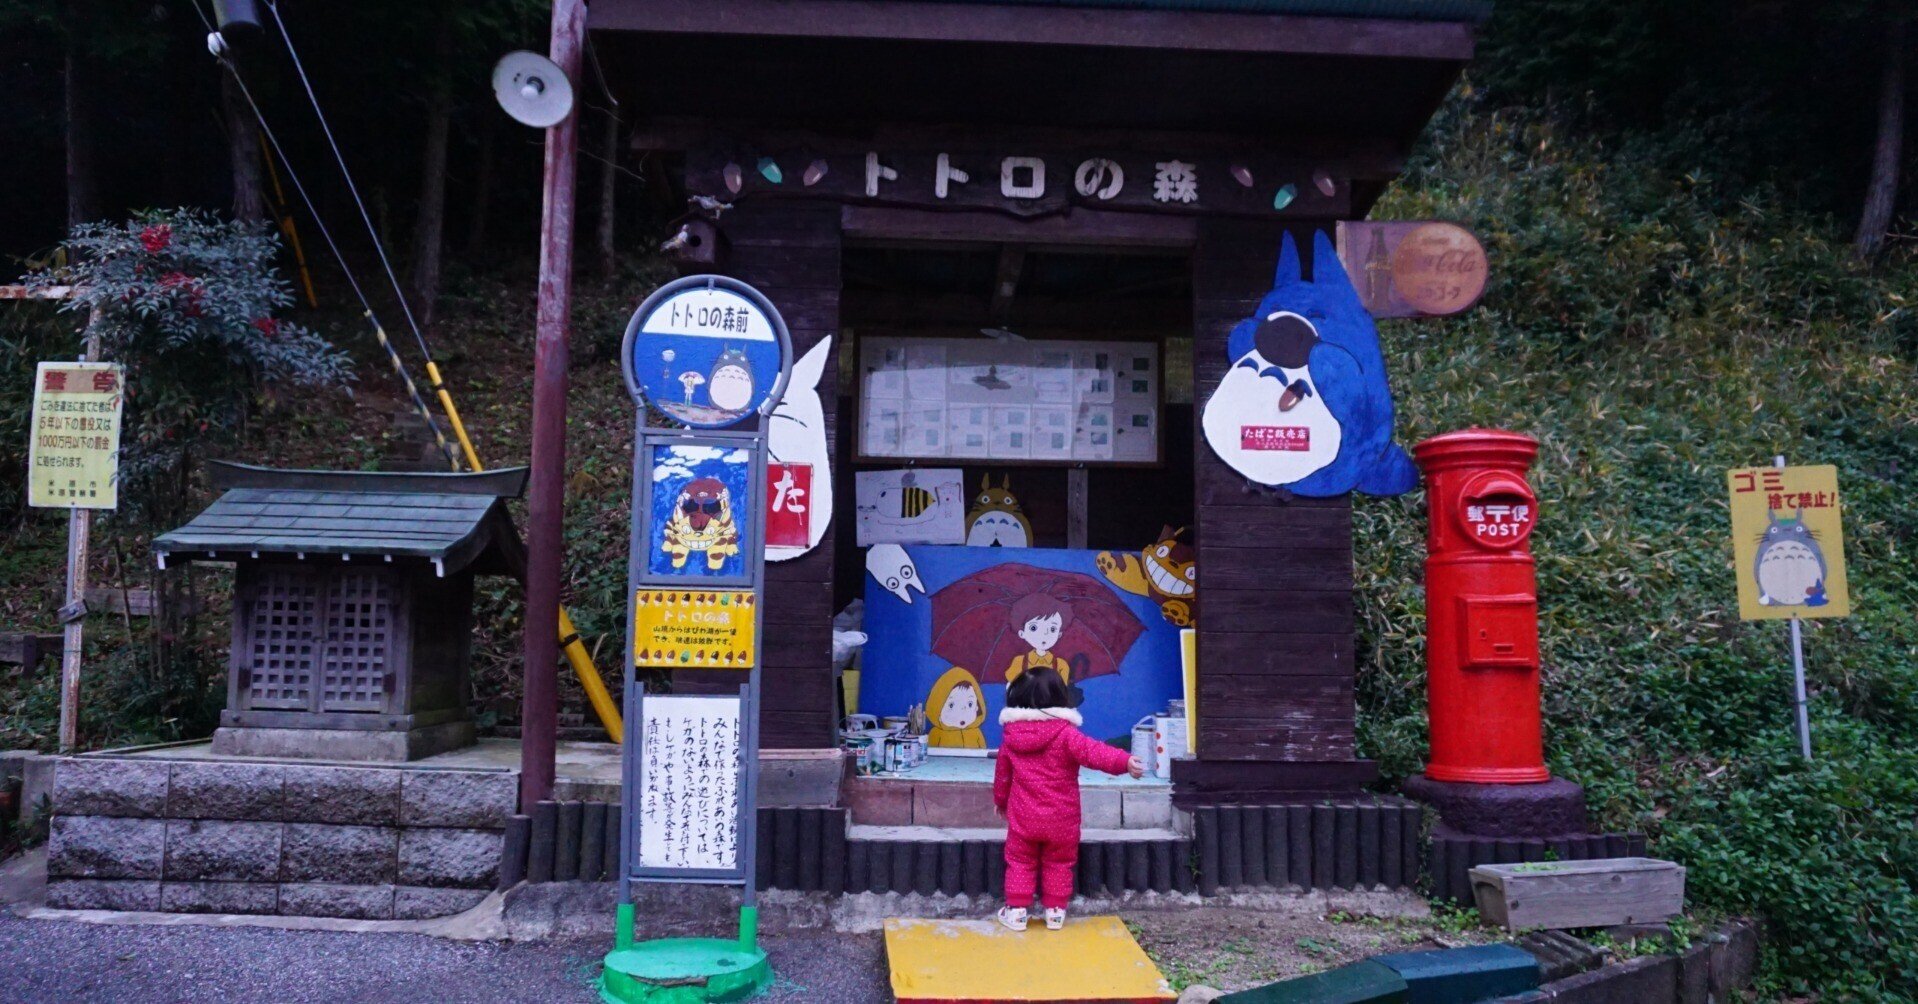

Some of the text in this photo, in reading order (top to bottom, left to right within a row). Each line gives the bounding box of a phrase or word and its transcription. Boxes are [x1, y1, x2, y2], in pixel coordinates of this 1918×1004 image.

[865, 152, 1199, 203] トトロの森
[671, 302, 749, 333] トトロの森前
[44, 371, 115, 391] 警告
[1245, 427, 1307, 439] たばこ販売店
[772, 470, 806, 513] た
[1734, 471, 1785, 493] ゴミ
[1477, 523, 1520, 536] POST
